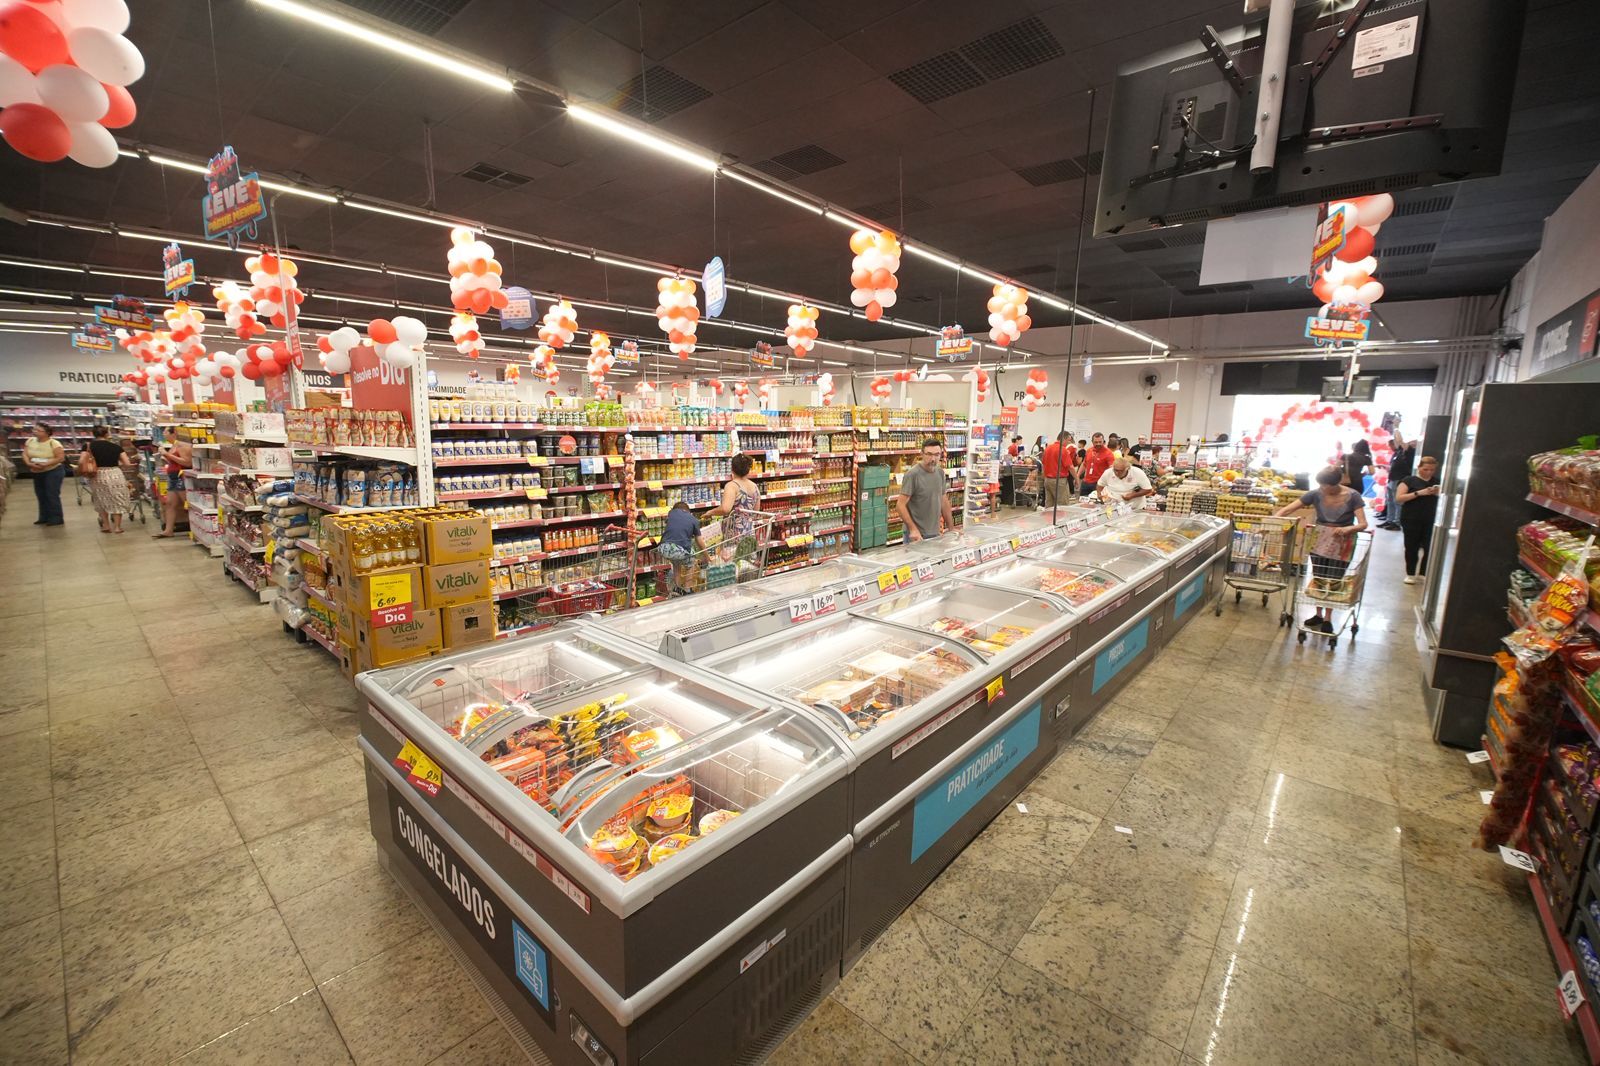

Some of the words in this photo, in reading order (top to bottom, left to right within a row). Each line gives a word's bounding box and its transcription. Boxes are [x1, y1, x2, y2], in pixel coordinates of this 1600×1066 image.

[206, 180, 249, 219] LEVE
[1309, 318, 1356, 332] LEVE
[447, 526, 478, 538] vitaliv
[436, 571, 479, 590] vitaliv
[816, 594, 833, 610] 16.99
[377, 607, 398, 616] Resolve
[385, 613, 406, 624] Dia
[947, 738, 1006, 803] PRATICIDADE
[398, 806, 496, 940] CONGELADOS
